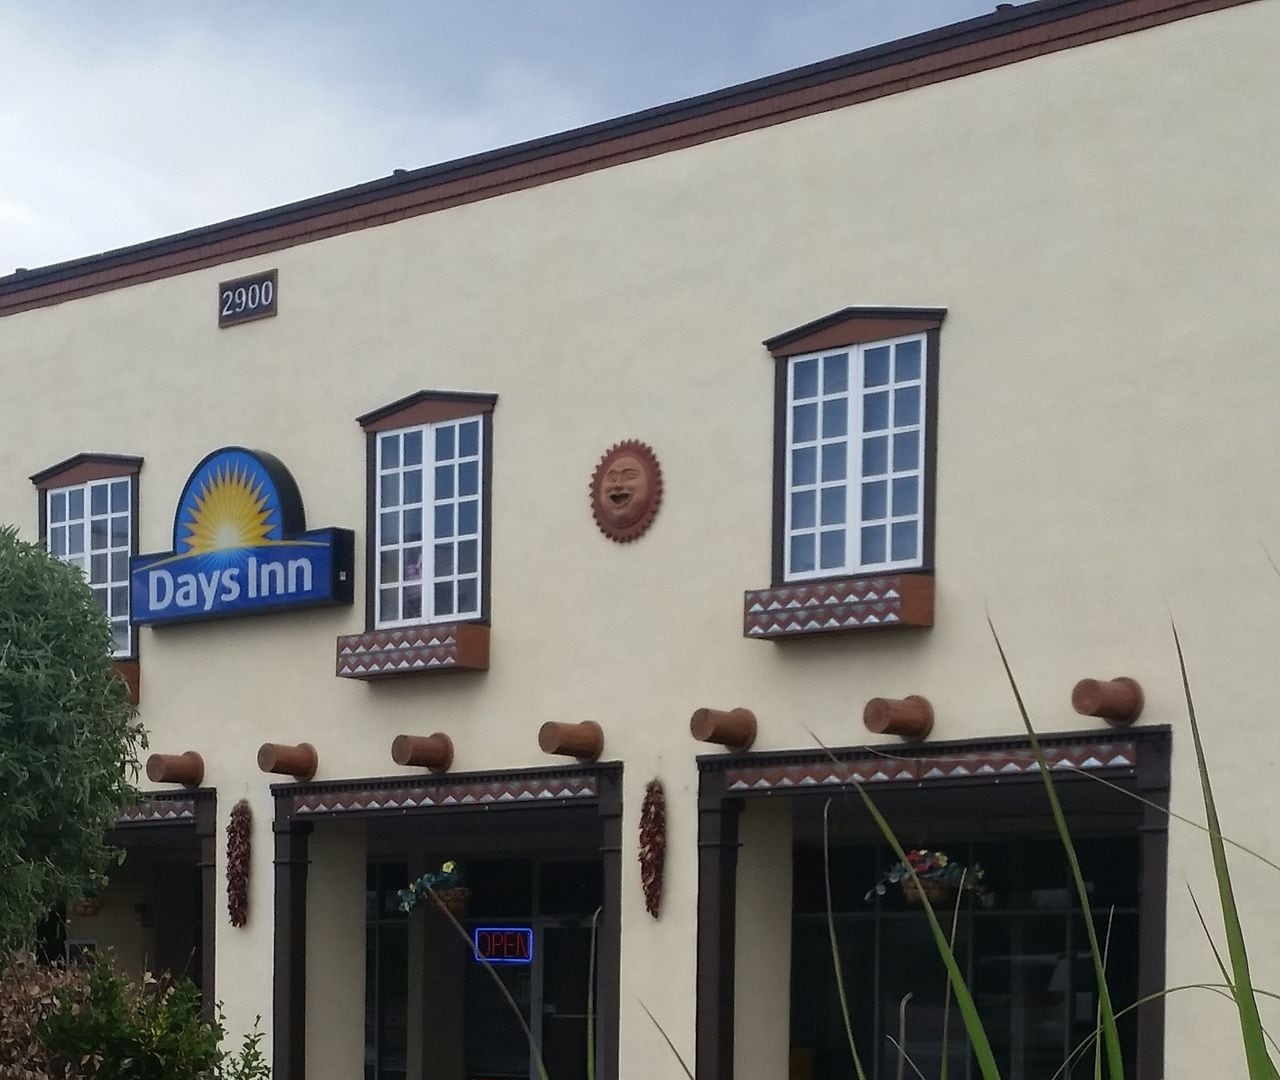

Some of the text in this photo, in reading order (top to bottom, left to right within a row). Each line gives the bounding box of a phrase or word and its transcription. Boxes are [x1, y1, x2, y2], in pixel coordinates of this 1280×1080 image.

[222, 281, 273, 316] 2900
[148, 556, 313, 611] Days Inn
[479, 932, 529, 958] OPEN
